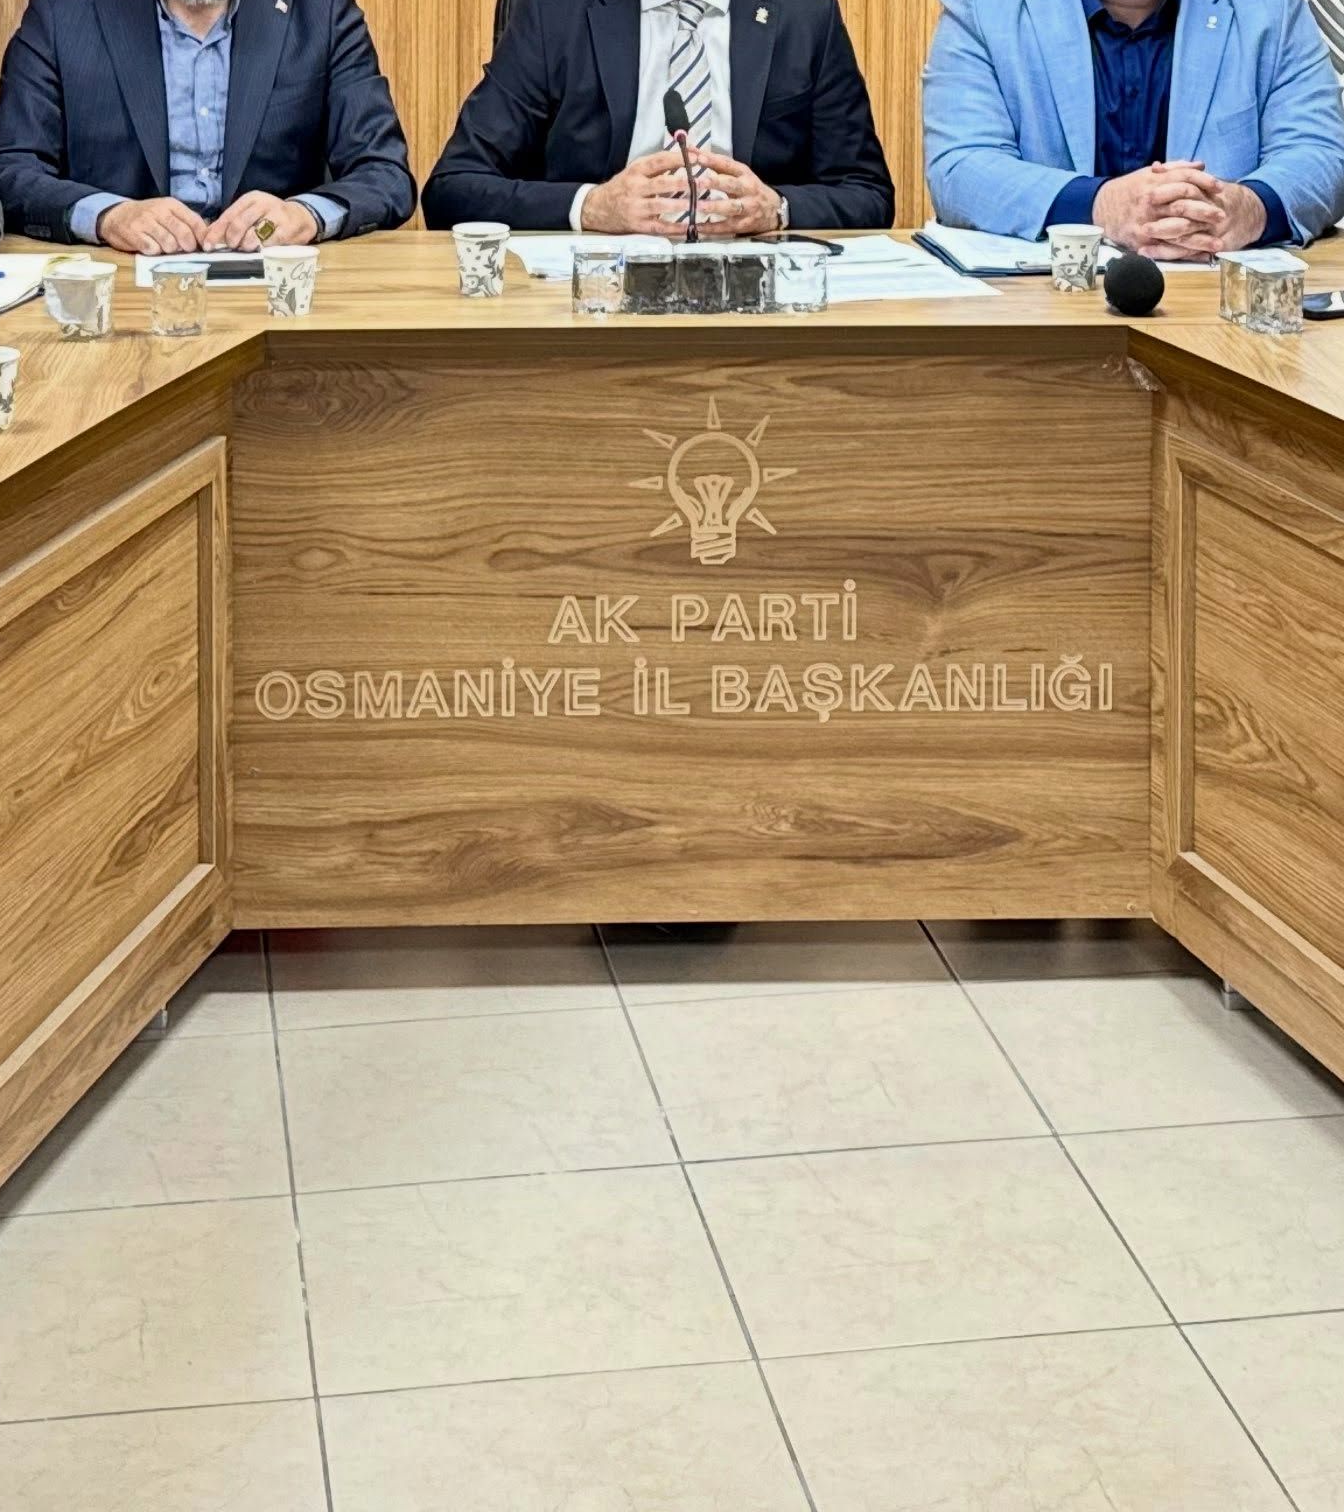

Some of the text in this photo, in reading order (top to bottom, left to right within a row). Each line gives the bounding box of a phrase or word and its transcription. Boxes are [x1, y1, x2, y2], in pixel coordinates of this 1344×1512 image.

[547, 578, 858, 644] AK PARTİ
[255, 653, 1114, 724] OSMANİYE İL BAŞKANLIĞI
